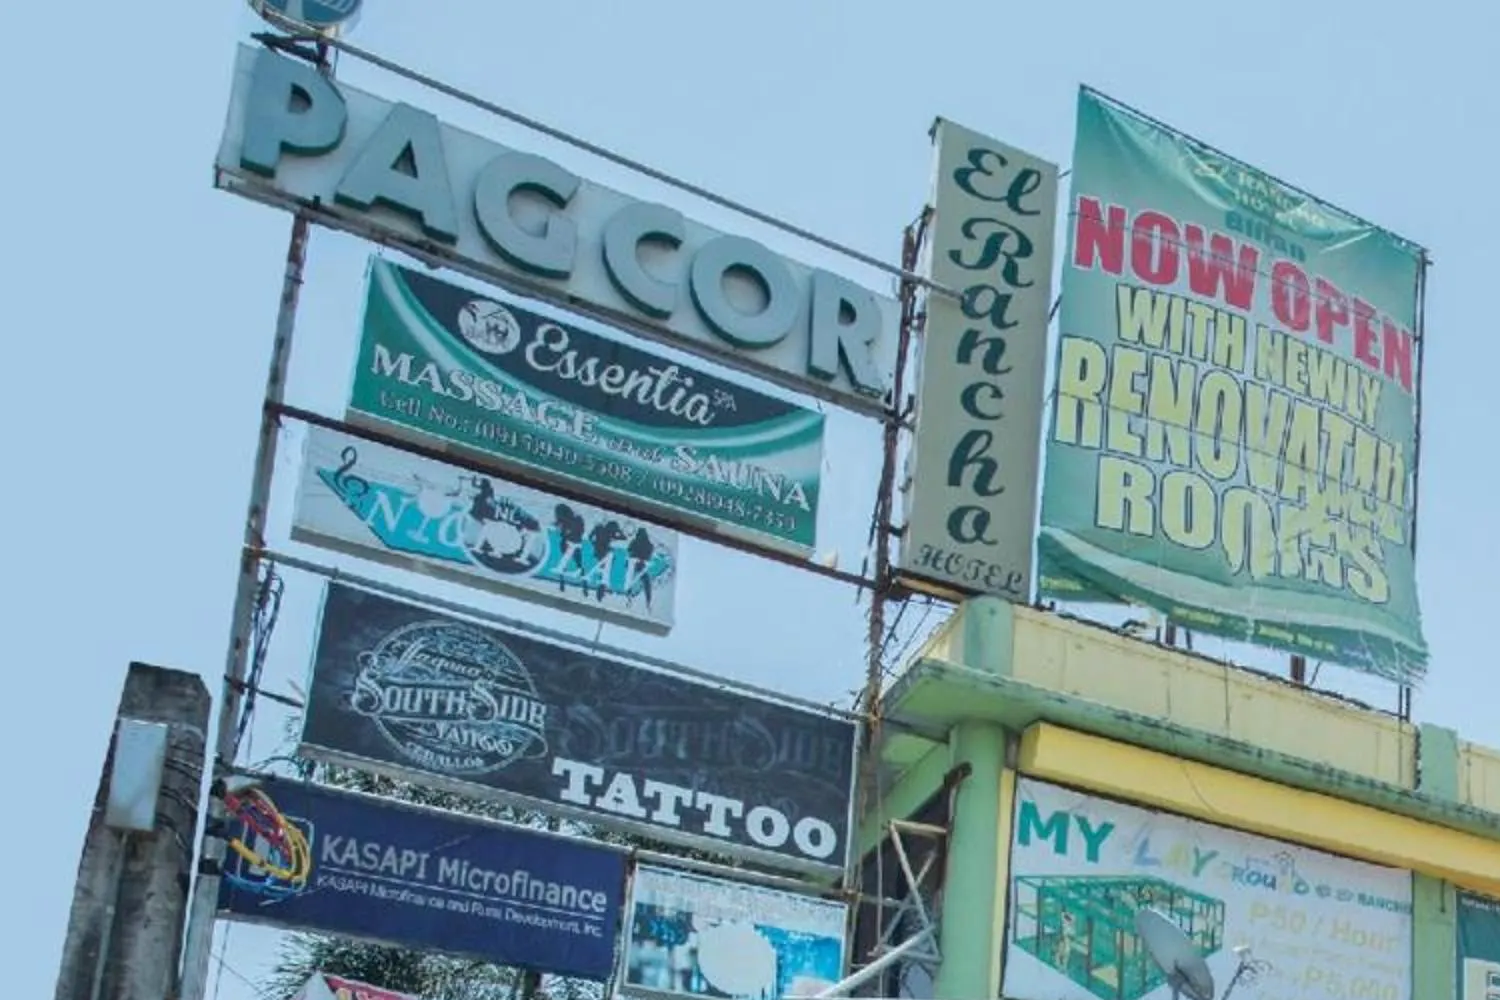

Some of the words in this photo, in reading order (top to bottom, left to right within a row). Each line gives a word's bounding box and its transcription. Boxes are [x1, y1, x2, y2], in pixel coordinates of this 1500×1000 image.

[238, 44, 884, 397] PAGCOR
[953, 147, 1041, 216] El
[1072, 194, 1260, 311] NOW
[1270, 259, 1414, 393] OPEN
[1115, 282, 1247, 372] WITH
[525, 323, 717, 428] Essentia
[946, 217, 1034, 546] Rancho
[371, 344, 600, 441] MASSAGE
[671, 445, 811, 512] SAUNA
[913, 543, 1023, 595] HOTEL
[552, 756, 838, 859] TATTOO
[1016, 799, 1116, 864] MY
[321, 834, 431, 879] KASAPI
[438, 857, 608, 913] Microfinance
